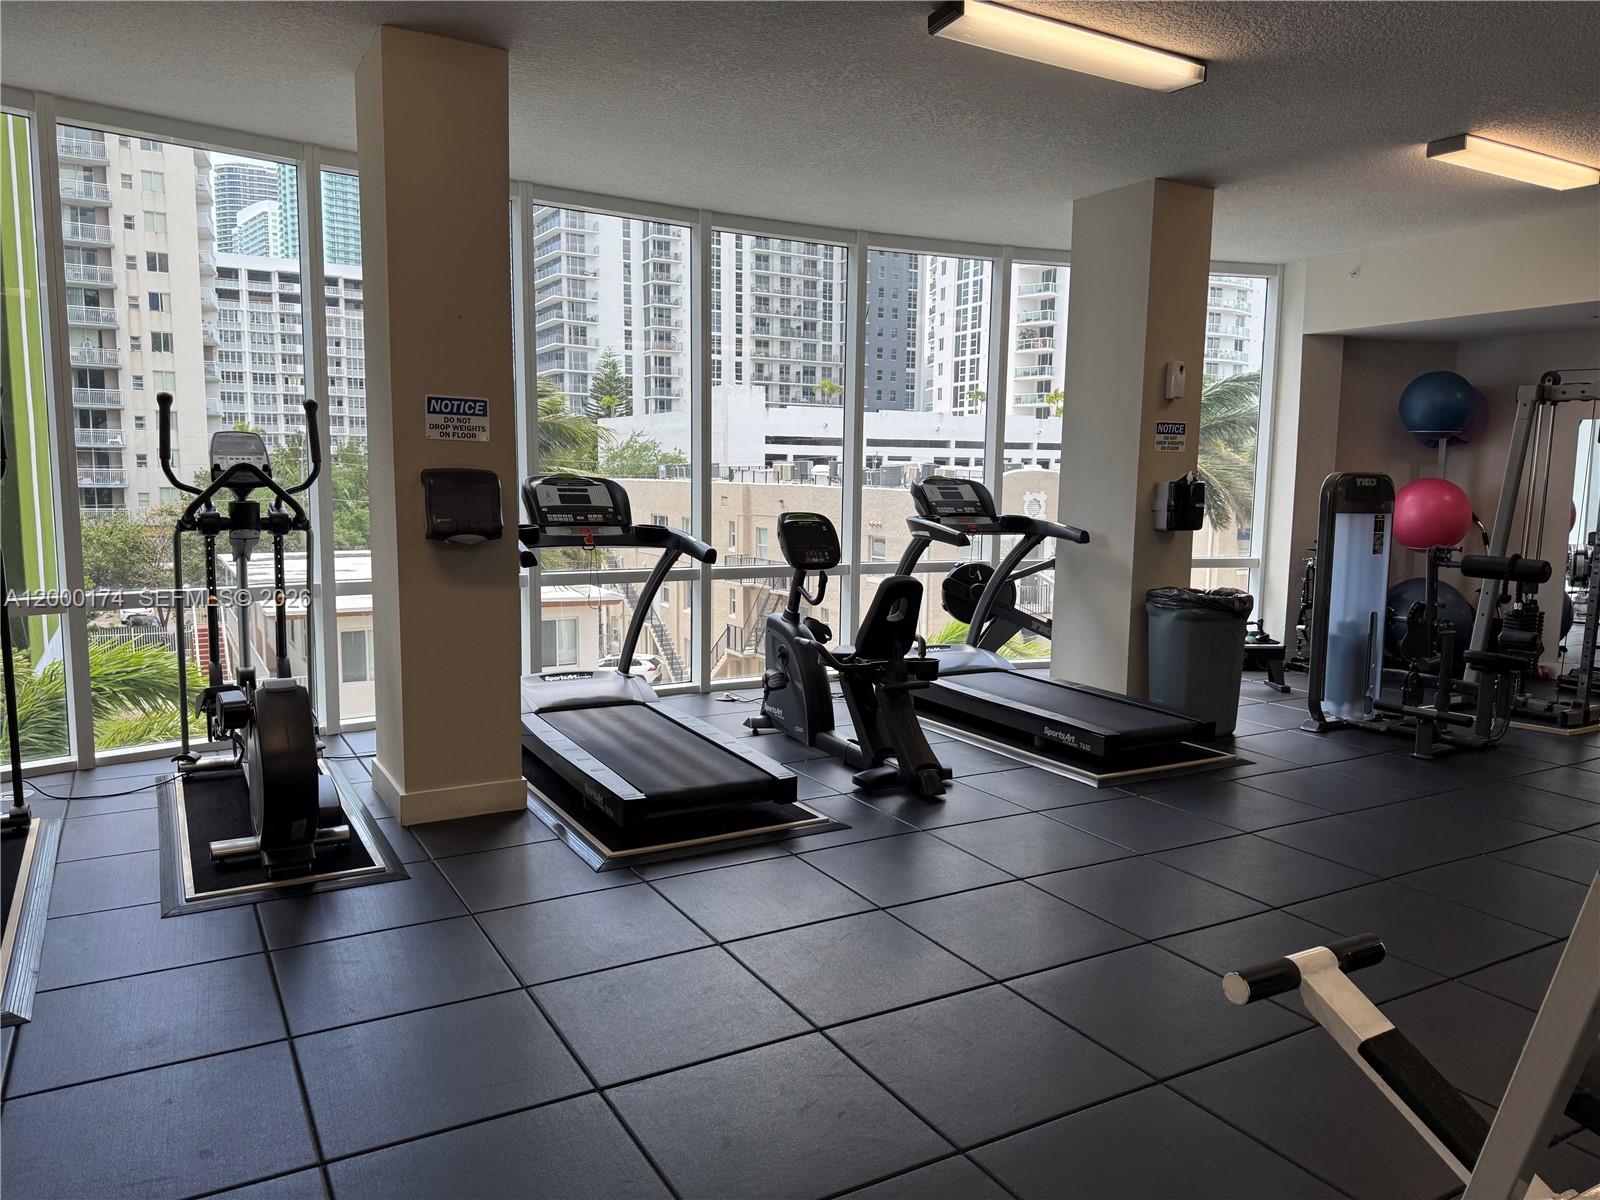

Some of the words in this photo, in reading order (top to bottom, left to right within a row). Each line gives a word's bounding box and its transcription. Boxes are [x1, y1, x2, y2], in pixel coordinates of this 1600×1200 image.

[429, 399, 485, 415] NOTICE
[443, 416, 455, 424] DO
[456, 417, 472, 425] NOT
[428, 423, 451, 431] DROP
[452, 424, 487, 432] WEIGHTS
[1157, 423, 1185, 433] NOTICE
[452, 431, 477, 439] FLOOR
[1043, 726, 1075, 743] SportsArt
